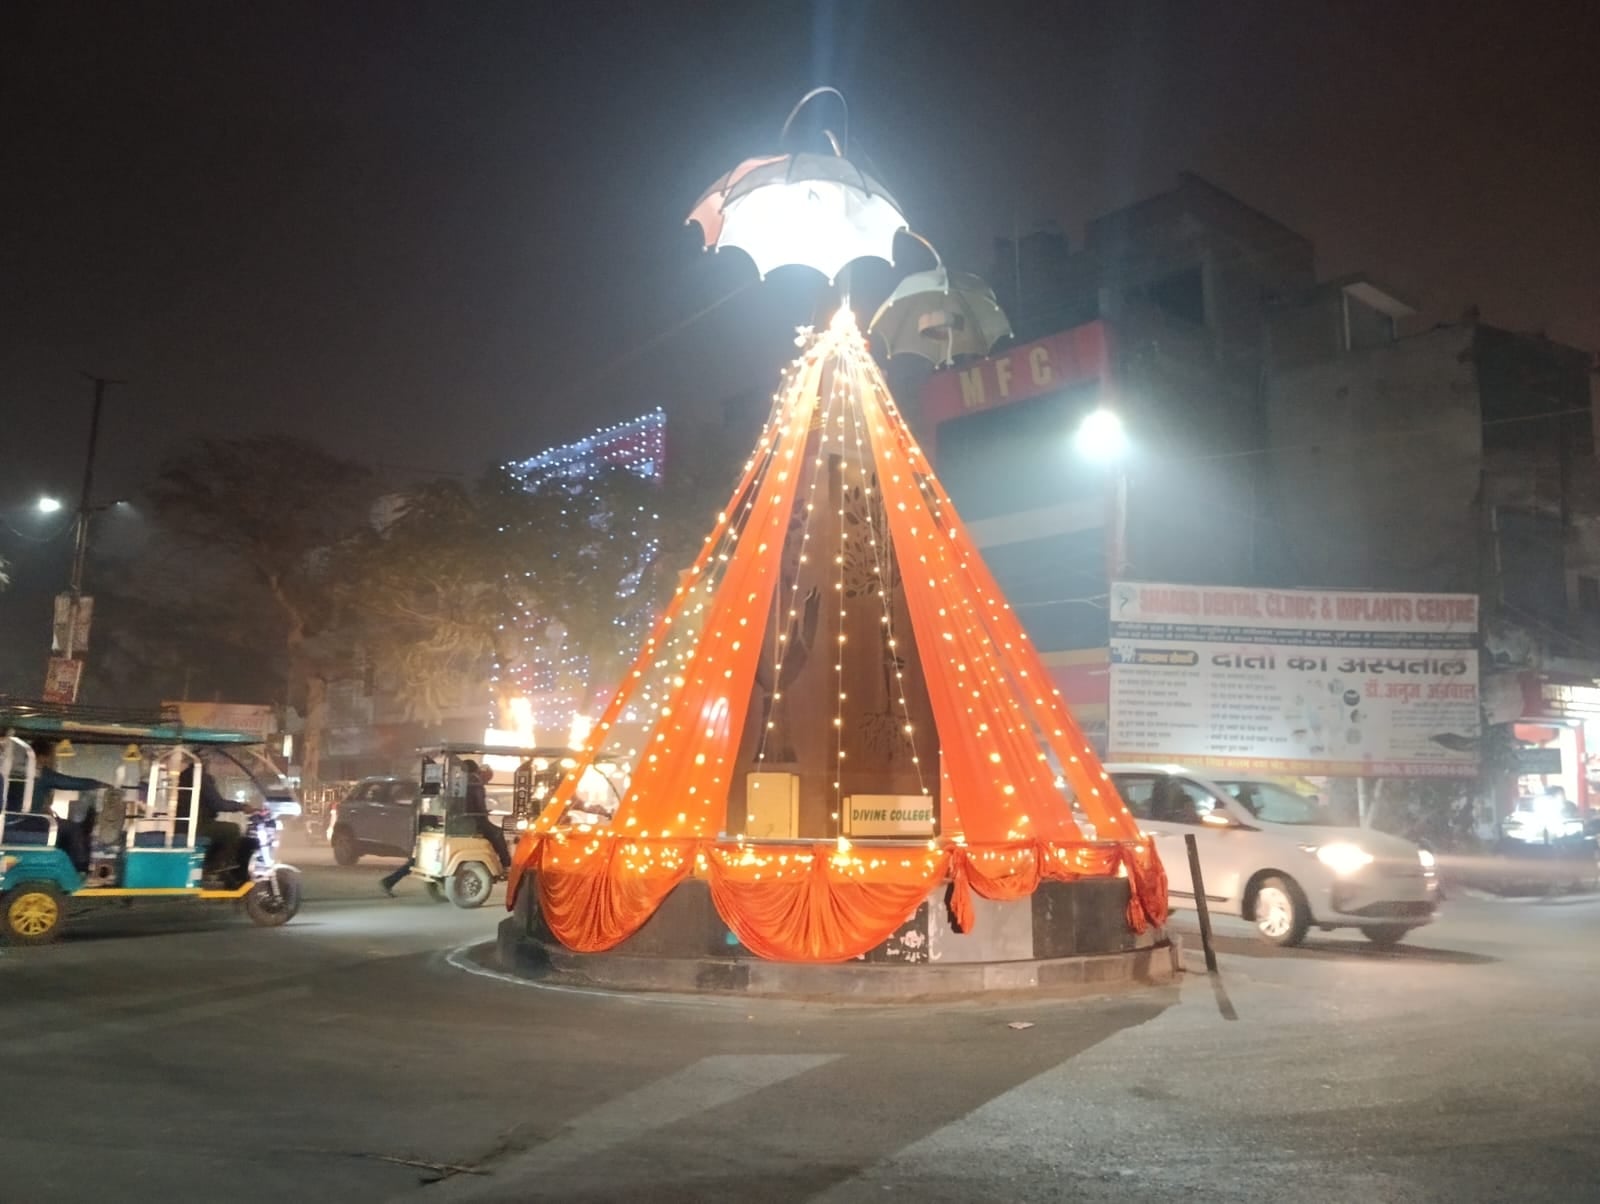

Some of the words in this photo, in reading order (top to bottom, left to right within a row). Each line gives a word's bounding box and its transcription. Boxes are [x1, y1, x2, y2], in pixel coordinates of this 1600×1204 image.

[1203, 591, 1264, 619] DENTAL
[1266, 592, 1317, 620] CLINIC
[1320, 596, 1333, 620] &
[1336, 596, 1412, 622] IMPLANTS
[1415, 598, 1475, 624] CENTRE
[1287, 652, 1327, 671] का
[1337, 653, 1467, 676] अस्पताल
[852, 809, 887, 821] DIVINE
[889, 809, 931, 821] COLLEGE
